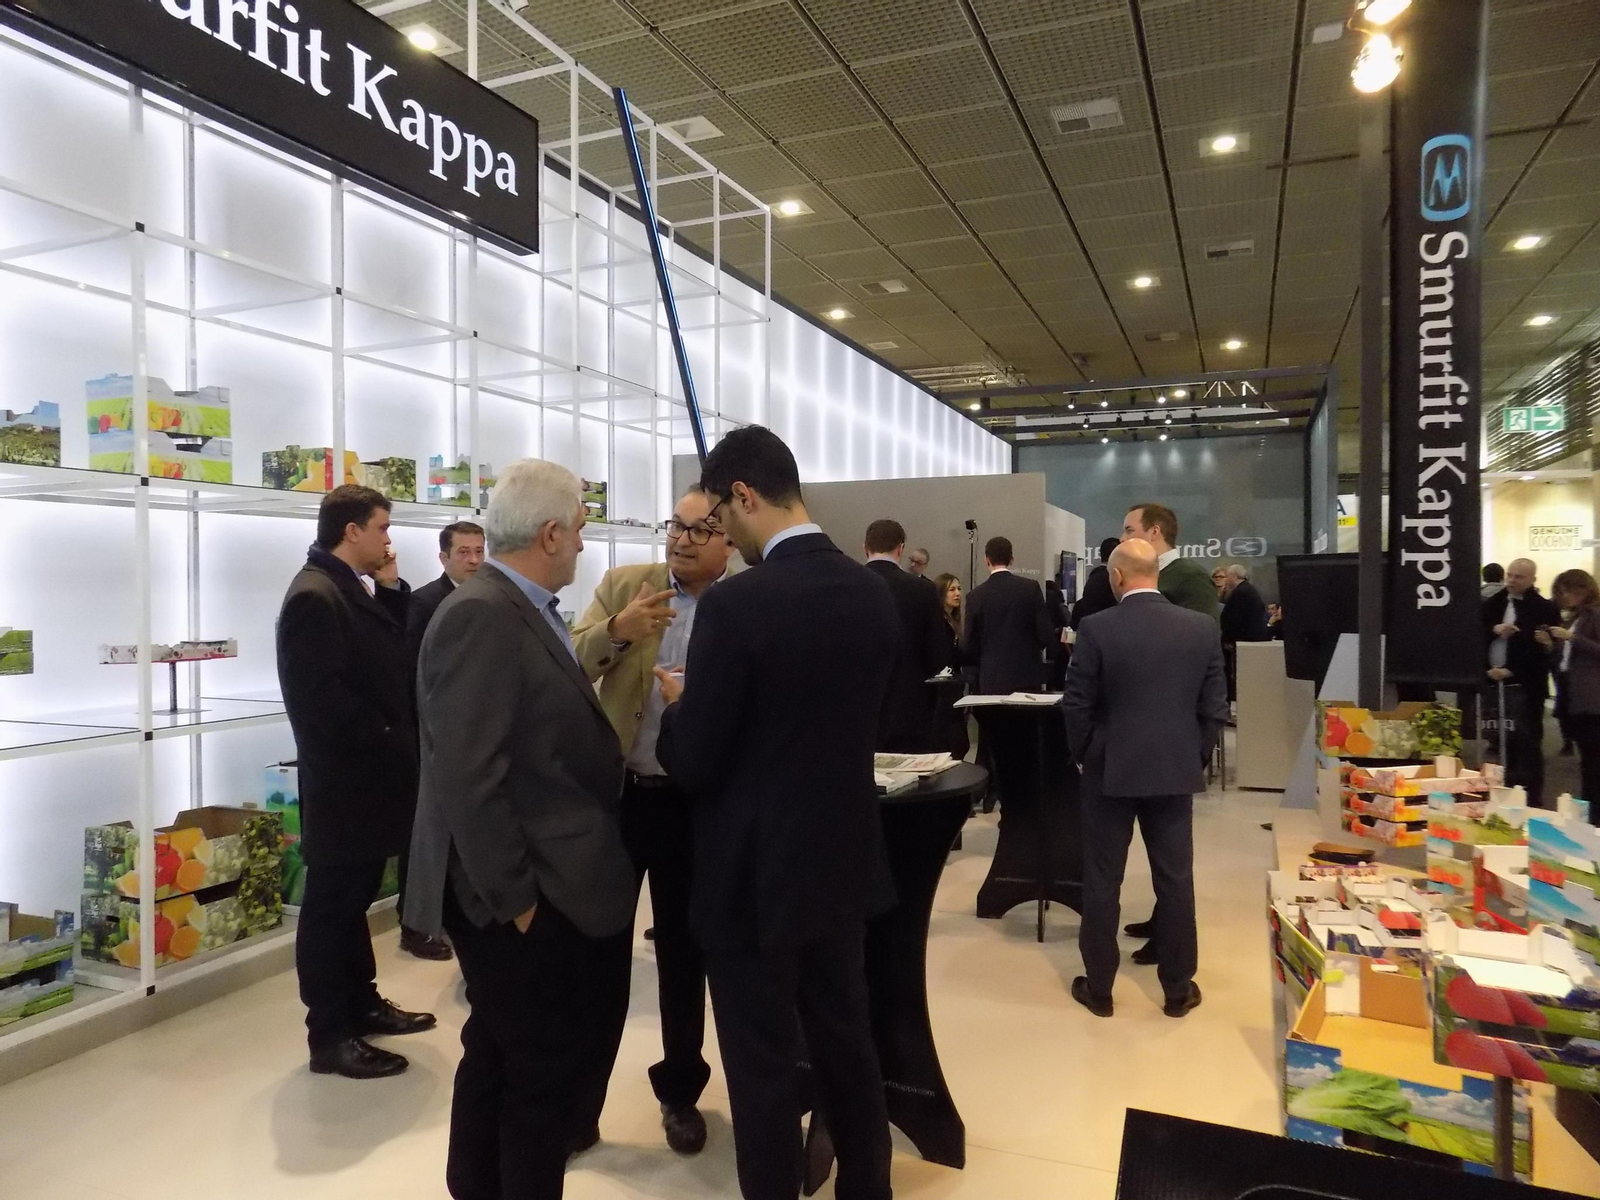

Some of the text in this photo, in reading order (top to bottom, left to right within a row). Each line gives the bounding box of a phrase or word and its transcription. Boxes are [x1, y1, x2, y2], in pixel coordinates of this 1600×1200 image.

[155, 0, 518, 197] urfit Kappa
[1401, 231, 1469, 609] Smurfit Kappa
